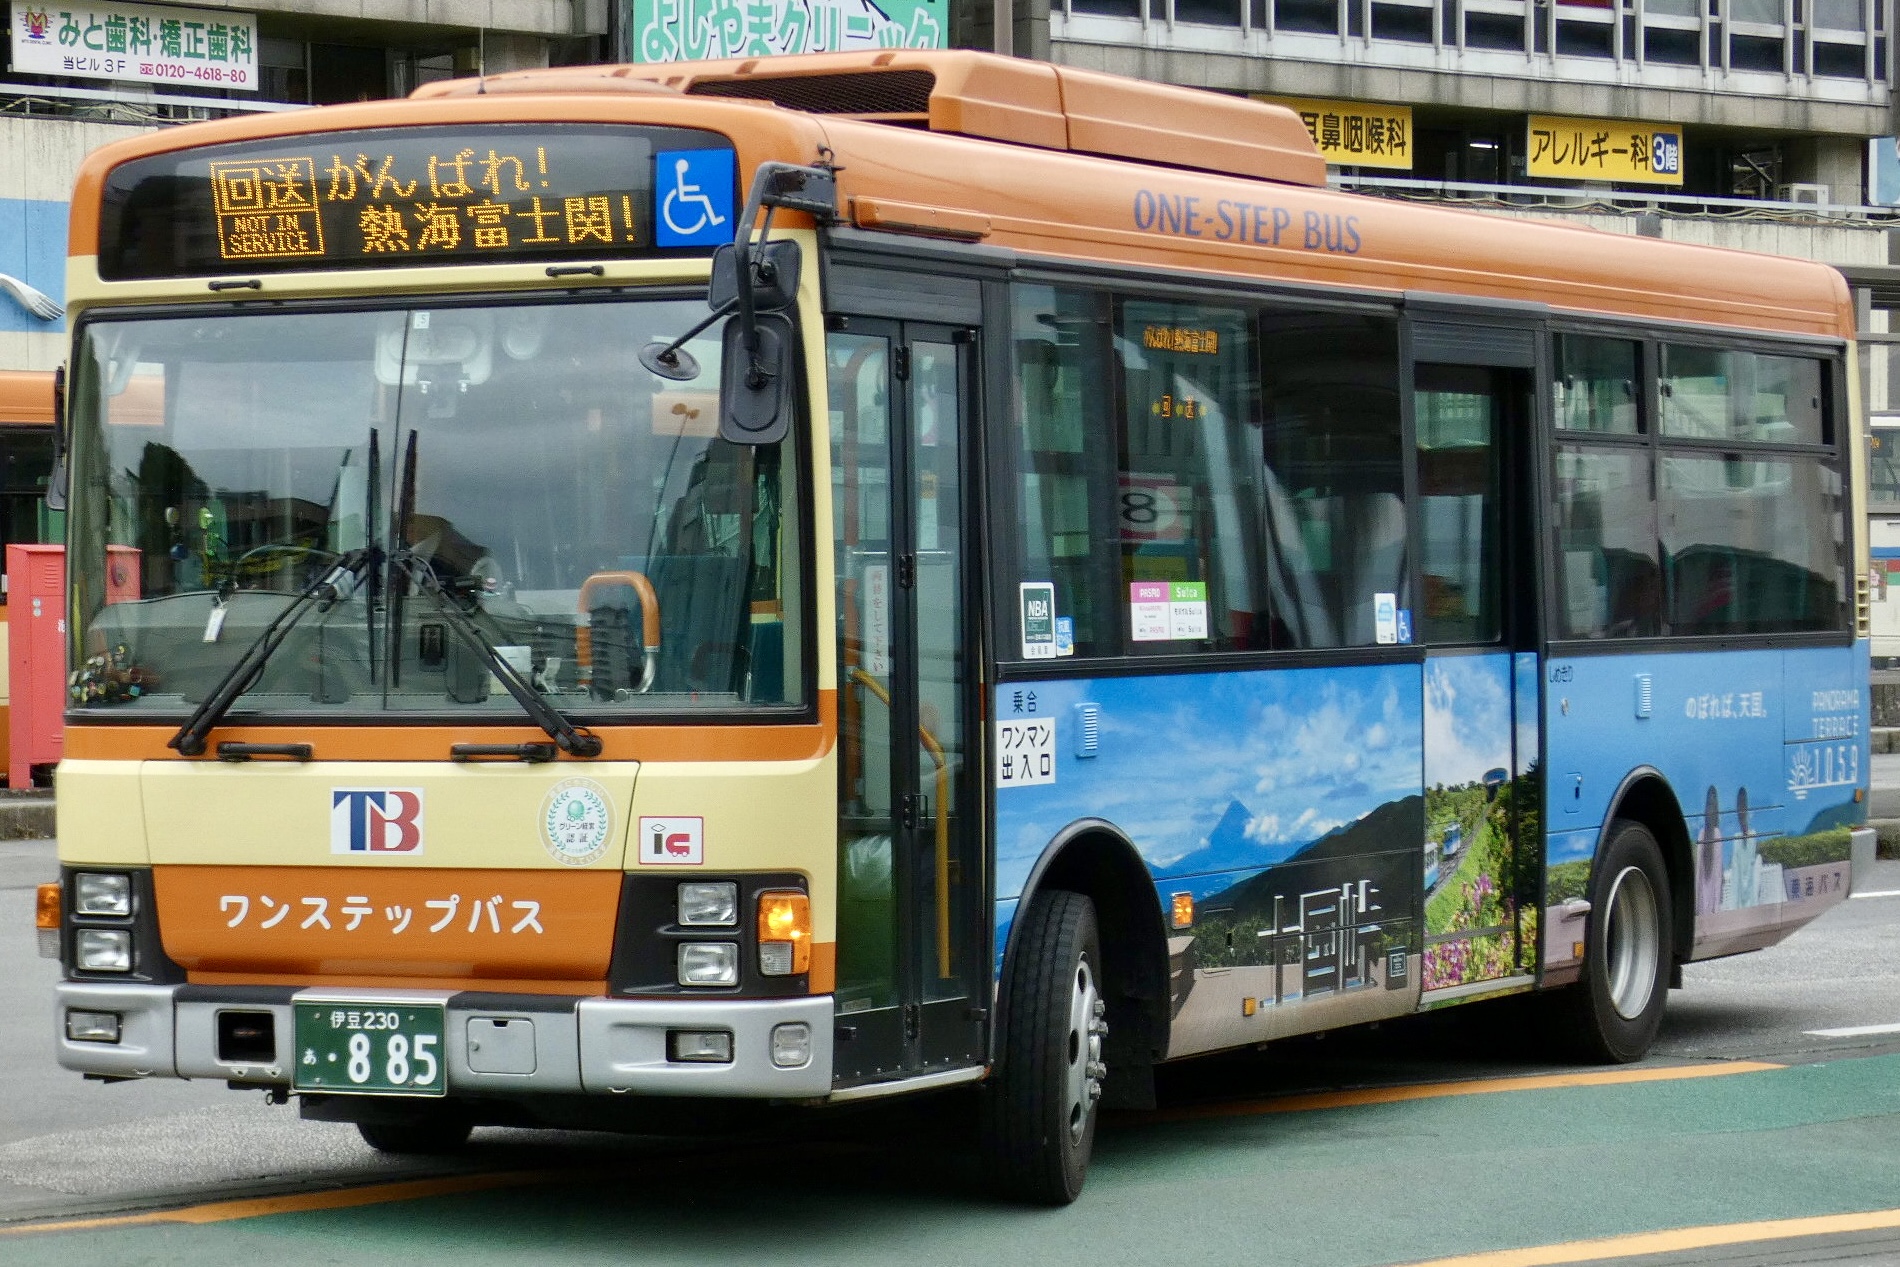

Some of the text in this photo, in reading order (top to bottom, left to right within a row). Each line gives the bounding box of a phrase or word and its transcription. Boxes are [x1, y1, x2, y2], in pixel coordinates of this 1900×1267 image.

[156, 64, 247, 83] 0120-4618-80
[1532, 129, 1649, 171] アレルギー科
[219, 163, 311, 211] 回送
[233, 213, 298, 232] NOT IN
[1134, 189, 1361, 254] ONE-STEP BUS
[229, 231, 310, 253] SERVICE
[1176, 586, 1199, 598] Suica
[1028, 600, 1048, 616] NBA
[1013, 691, 1038, 714] 乗合
[1812, 690, 1859, 711] PANORAMA
[1002, 724, 1050, 749] ワンマン
[1812, 715, 1859, 738] TERRACE
[1002, 753, 1050, 780] 出入口
[1814, 745, 1858, 784] 1059
[333, 790, 421, 852] TB
[219, 893, 544, 935] ワンステップバス
[330, 1011, 400, 1031] 伊豆230
